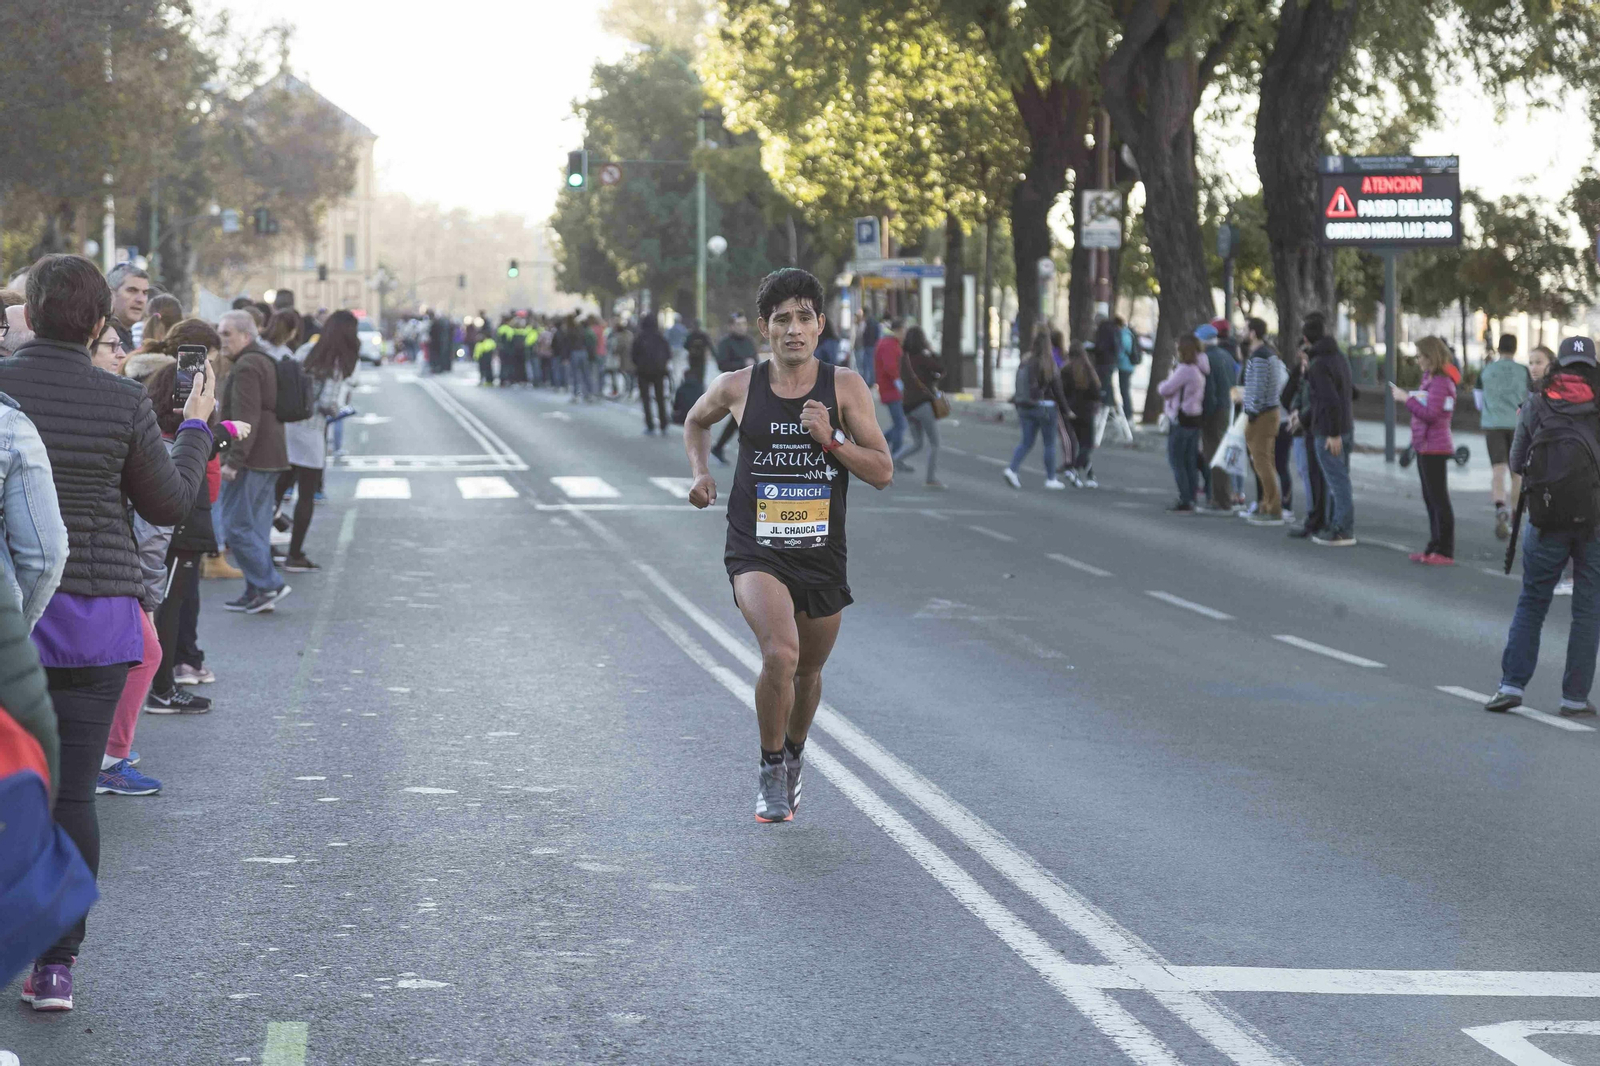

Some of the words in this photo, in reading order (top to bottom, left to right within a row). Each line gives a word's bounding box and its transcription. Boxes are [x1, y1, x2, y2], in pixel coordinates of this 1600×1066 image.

[1361, 175, 1423, 194] ATENCION
[1357, 199, 1397, 217] PASEO
[1397, 198, 1453, 217] DELICIAS
[770, 422, 811, 435] PERU
[753, 450, 826, 467] ZARUKA
[780, 488, 822, 497] ZURICH
[780, 510, 808, 521] 6230
[784, 525, 816, 535] CHAUCA
